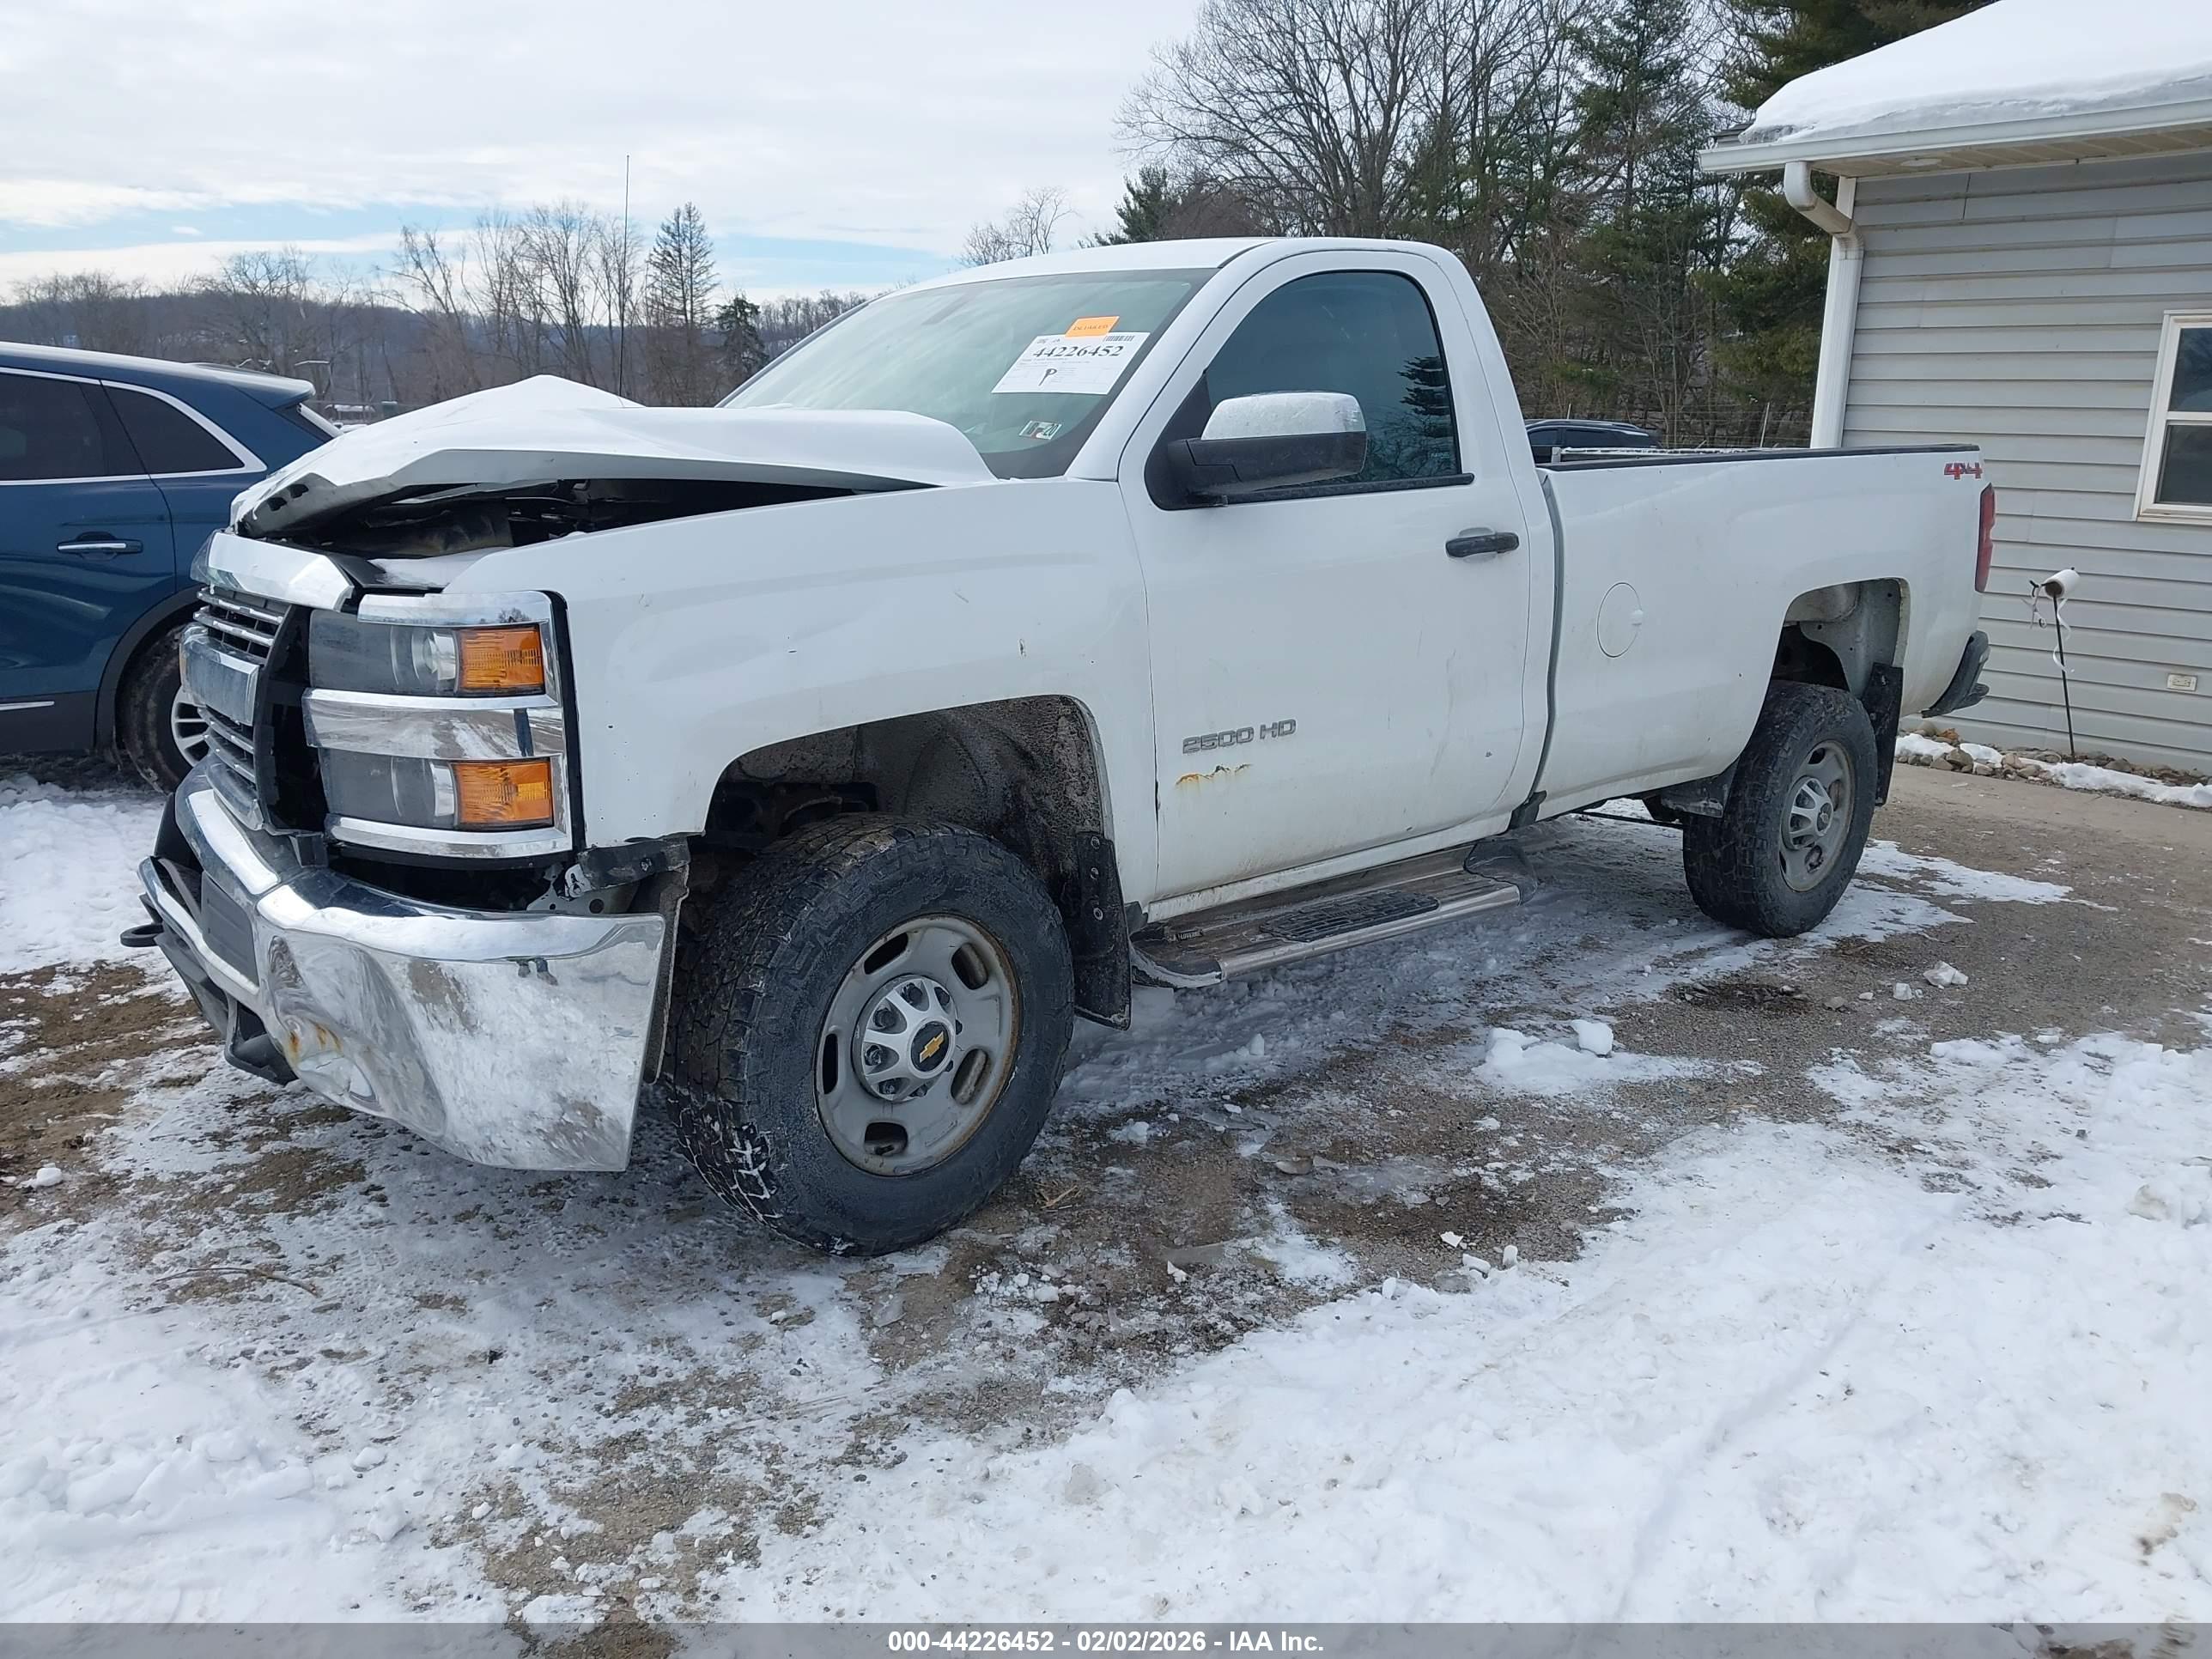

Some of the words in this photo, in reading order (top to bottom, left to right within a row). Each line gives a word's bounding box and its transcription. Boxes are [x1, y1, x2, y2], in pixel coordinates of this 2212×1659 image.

[1033, 345, 1124, 358] 44226452
[1038, 368, 1057, 386] P
[1182, 726, 1255, 754] 2500
[1260, 719, 1297, 739] HD
